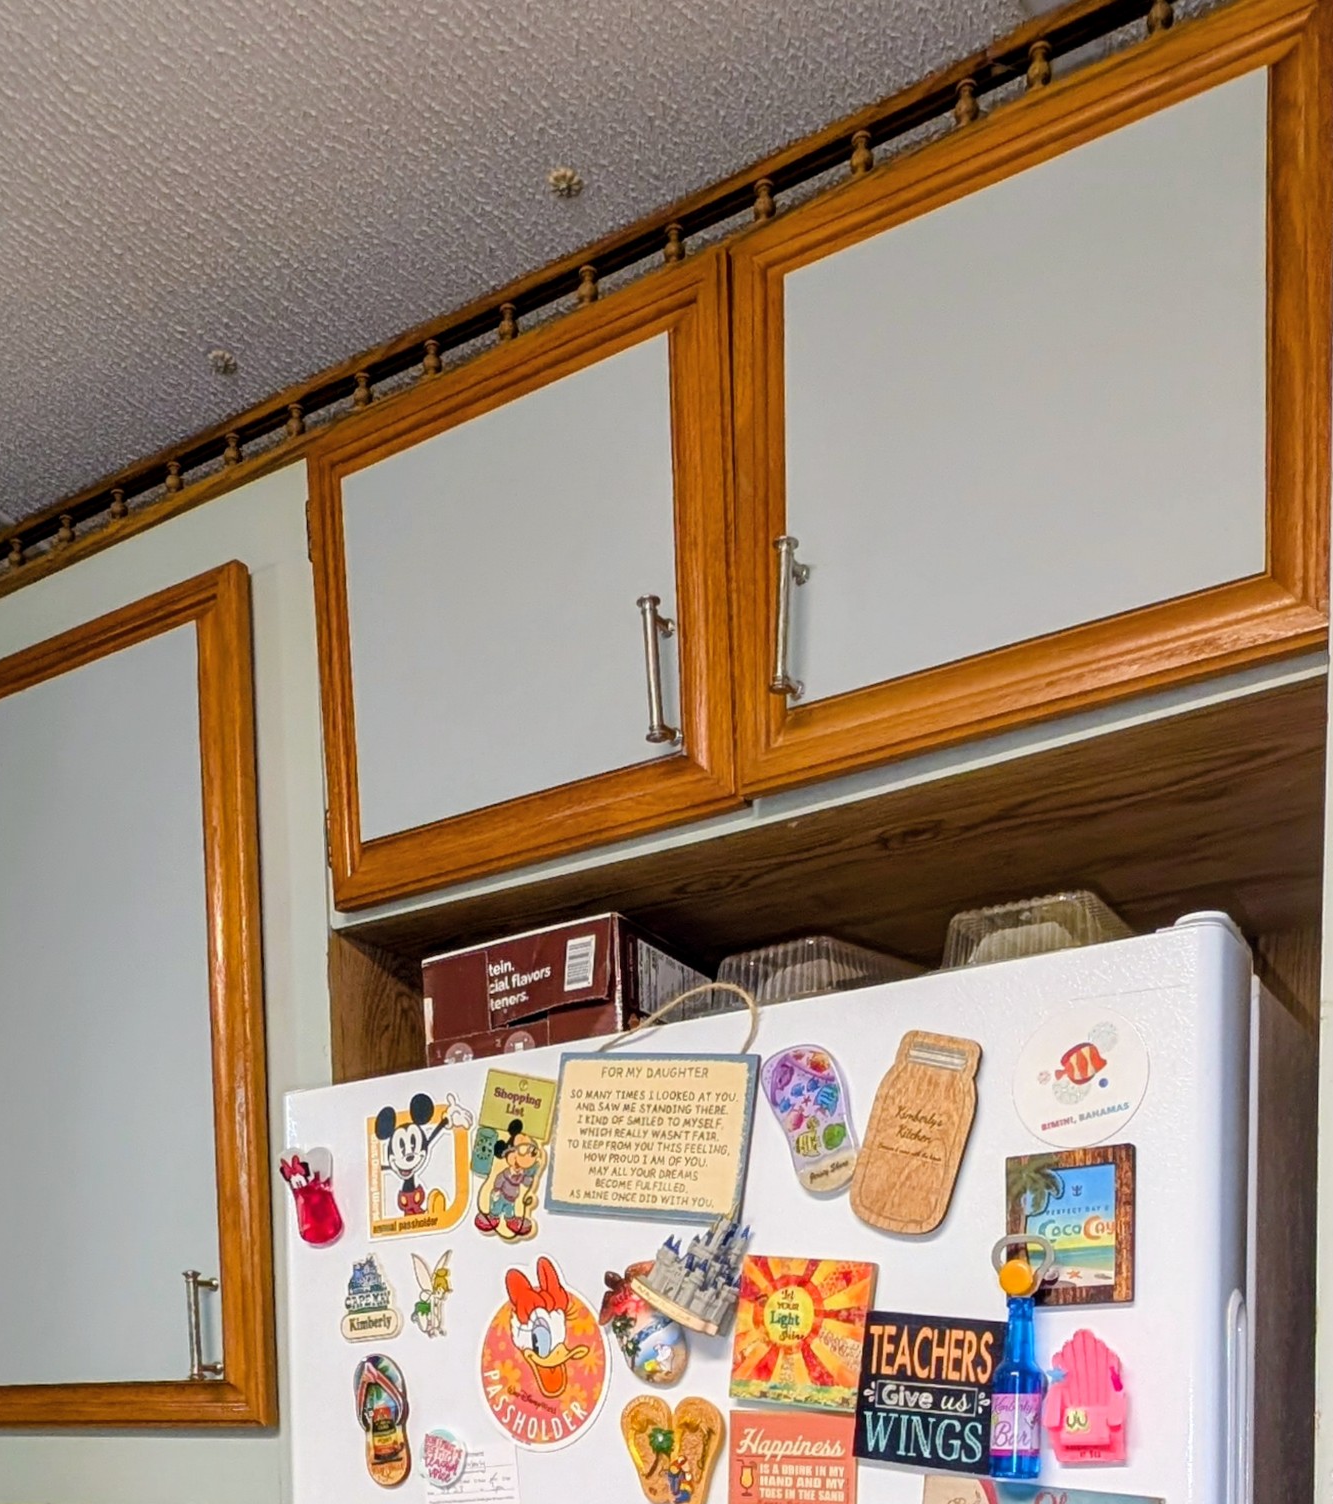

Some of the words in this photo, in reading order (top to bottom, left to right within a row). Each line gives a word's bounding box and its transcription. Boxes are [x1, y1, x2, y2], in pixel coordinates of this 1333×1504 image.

[512, 964, 552, 989] flavors
[601, 1066, 624, 1078] FOR
[625, 1067, 644, 1079] MY
[646, 1067, 709, 1079] DAUGHTER
[494, 1087, 542, 1107] Shopping
[585, 1089, 612, 1100] MANY
[615, 1089, 646, 1101] TIMES
[656, 1091, 695, 1102] LOOKED
[505, 1104, 525, 1117] List
[597, 1102, 621, 1113] SAW
[639, 1104, 693, 1115] STANDING
[1079, 1102, 1130, 1121] BAHAMAS
[585, 1115, 609, 1125] KIND
[627, 1116, 664, 1127] SMILED
[579, 1127, 613, 1137] WHICH
[614, 1128, 648, 1139] REALLY
[651, 1129, 690, 1141] WASN'T
[896, 1124, 932, 1144] Kitchen
[582, 1140, 605, 1150] KEEP
[606, 1141, 632, 1151] FROM
[657, 1142, 683, 1153] THIS
[583, 1153, 607, 1163] HOW
[608, 1154, 640, 1164] PROUD
[588, 1166, 609, 1176] MAY
[630, 1168, 657, 1179] YOUR
[658, 1169, 699, 1181] DREAMS
[595, 1178, 632, 1190] BECOME
[583, 1190, 609, 1200] MINE
[611, 1191, 636, 1202] ONCE
[638, 1193, 657, 1204] DID
[661, 1194, 689, 1206] WITH
[398, 1216, 439, 1231] passholder
[349, 1313, 393, 1332] Kimberly
[770, 1310, 800, 1329] Light
[869, 1325, 995, 1385] TEACHERS
[483, 1368, 589, 1441] PASSHOLDER
[881, 1383, 934, 1410] Give
[940, 1393, 974, 1412] us
[864, 1410, 983, 1464] WINGS
[736, 1428, 846, 1462] Happiness
[781, 1464, 813, 1477] DRINK
[829, 1466, 845, 1478] MY
[759, 1475, 793, 1487] HAND
[796, 1477, 822, 1488] AND
[826, 1478, 845, 1489] MY
[759, 1487, 783, 1499] TOES
[798, 1489, 816, 1500] THE
[818, 1490, 845, 1502] SAND
